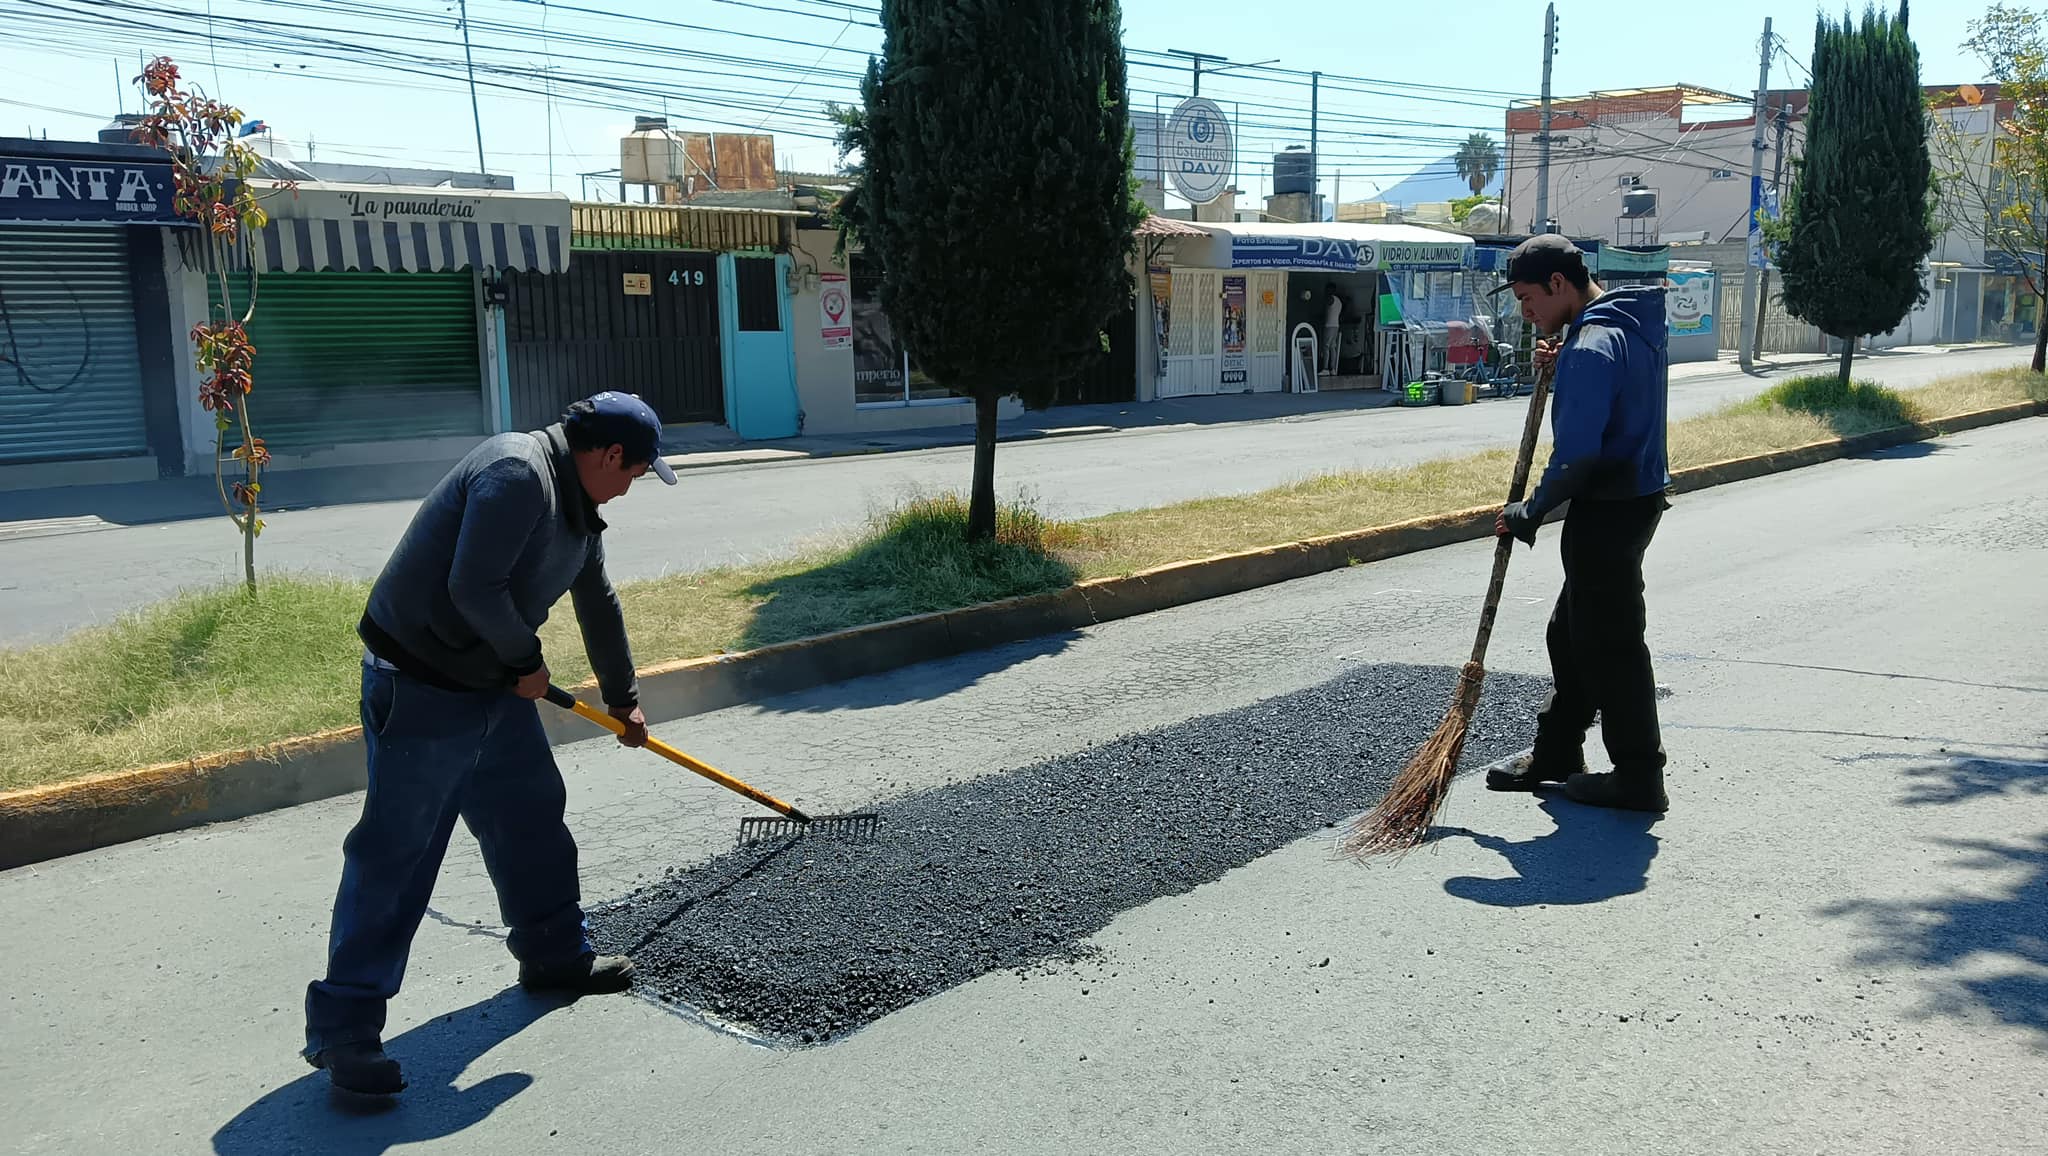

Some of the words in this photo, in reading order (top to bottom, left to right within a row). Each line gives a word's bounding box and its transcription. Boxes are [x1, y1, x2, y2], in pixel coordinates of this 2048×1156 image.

[1176, 141, 1225, 160] Estudios
[1182, 161, 1219, 176] DAV
[1302, 239, 1358, 259] DAV
[1383, 247, 1412, 261] VIDRIO
[1414, 247, 1419, 261] Y
[1420, 247, 1459, 261] ALUMINIO
[668, 269, 704, 286] 419
